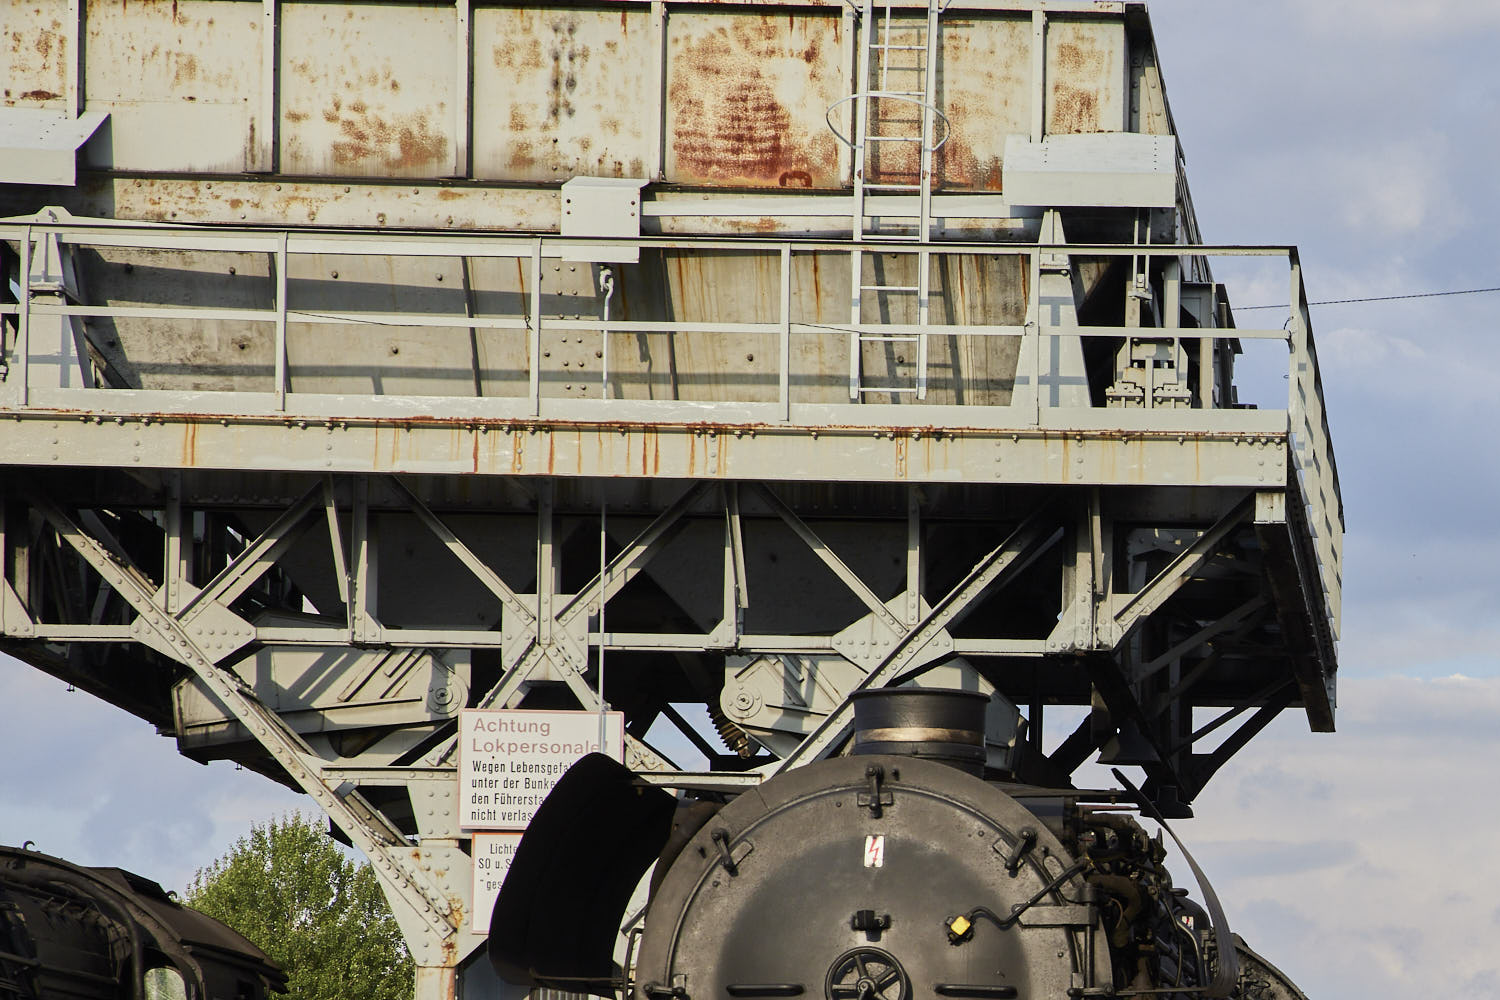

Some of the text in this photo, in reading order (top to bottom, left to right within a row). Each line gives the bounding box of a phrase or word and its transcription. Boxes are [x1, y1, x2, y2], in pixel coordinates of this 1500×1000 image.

[473, 718, 550, 737] Achtung
[472, 760, 572, 775] Wegen Lebensgefa
[472, 777, 499, 789] unter
[503, 777, 520, 789] der
[471, 793, 489, 804] den
[471, 809, 496, 820] nicht
